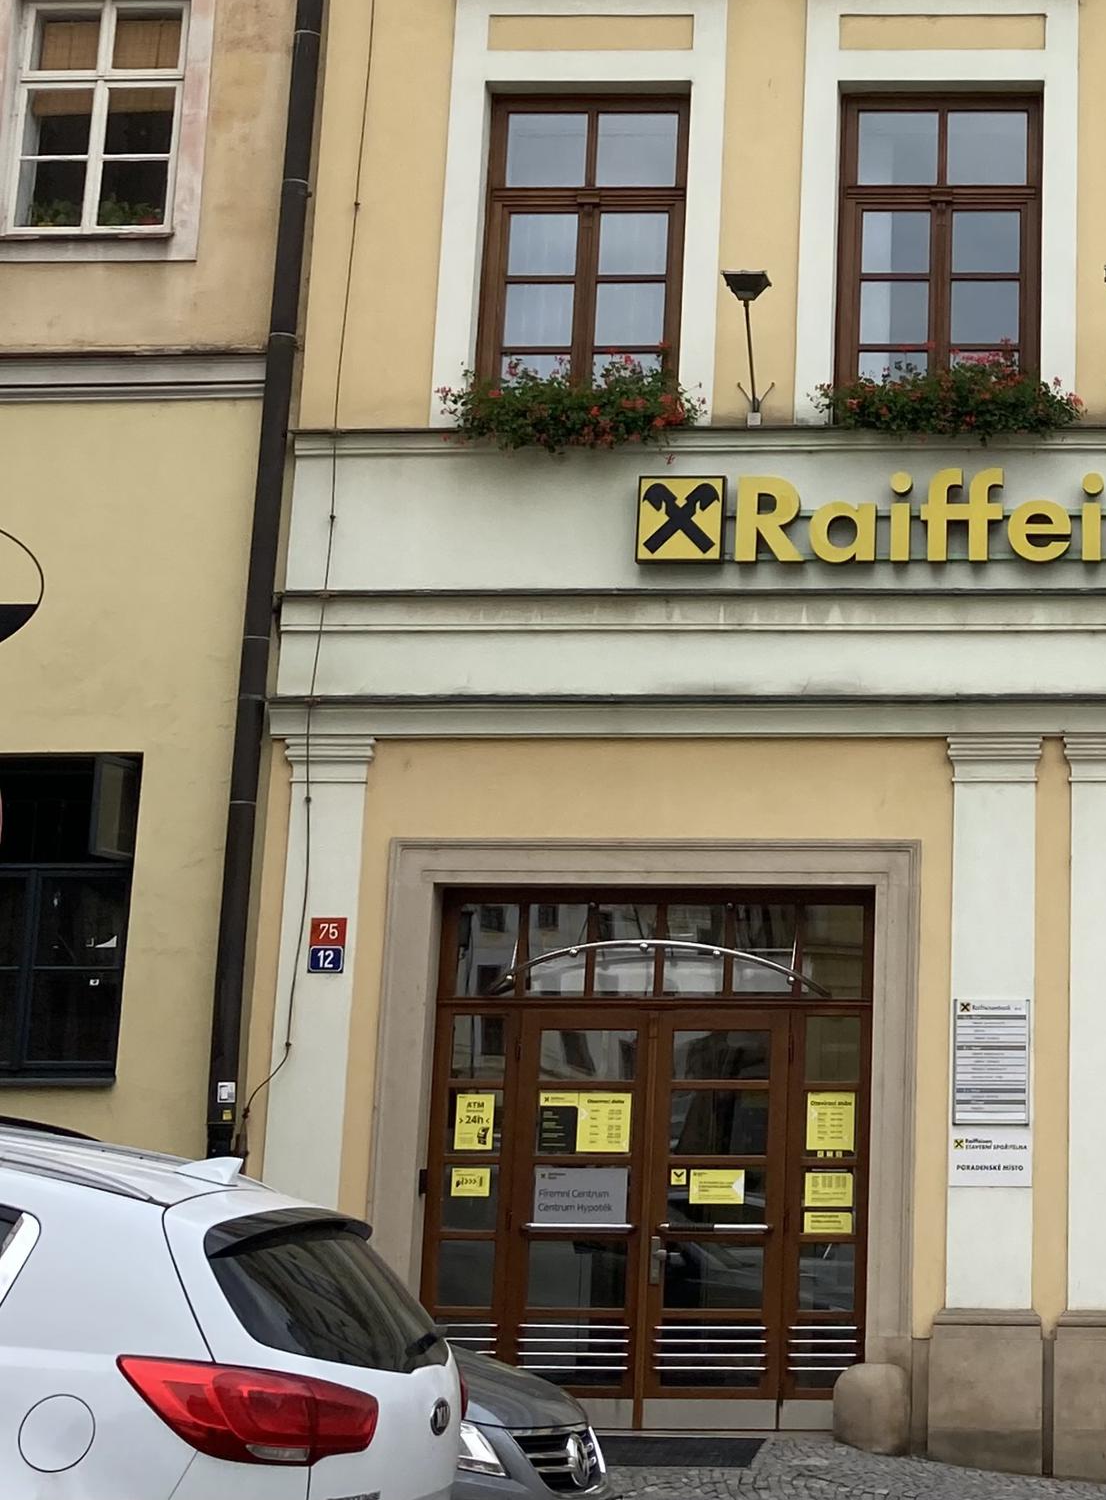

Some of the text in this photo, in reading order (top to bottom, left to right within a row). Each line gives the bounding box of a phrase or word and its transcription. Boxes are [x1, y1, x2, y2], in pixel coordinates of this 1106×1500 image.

[319, 923, 338, 940] 75
[317, 950, 334, 968] 12
[466, 1101, 485, 1109] ATM
[465, 1115, 484, 1124] 24h
[956, 1163, 1024, 1171] PORADENSKÉ MÍSTO
[538, 1188, 610, 1198] Firemní Centrum
[537, 1203, 576, 1212] Centrum
